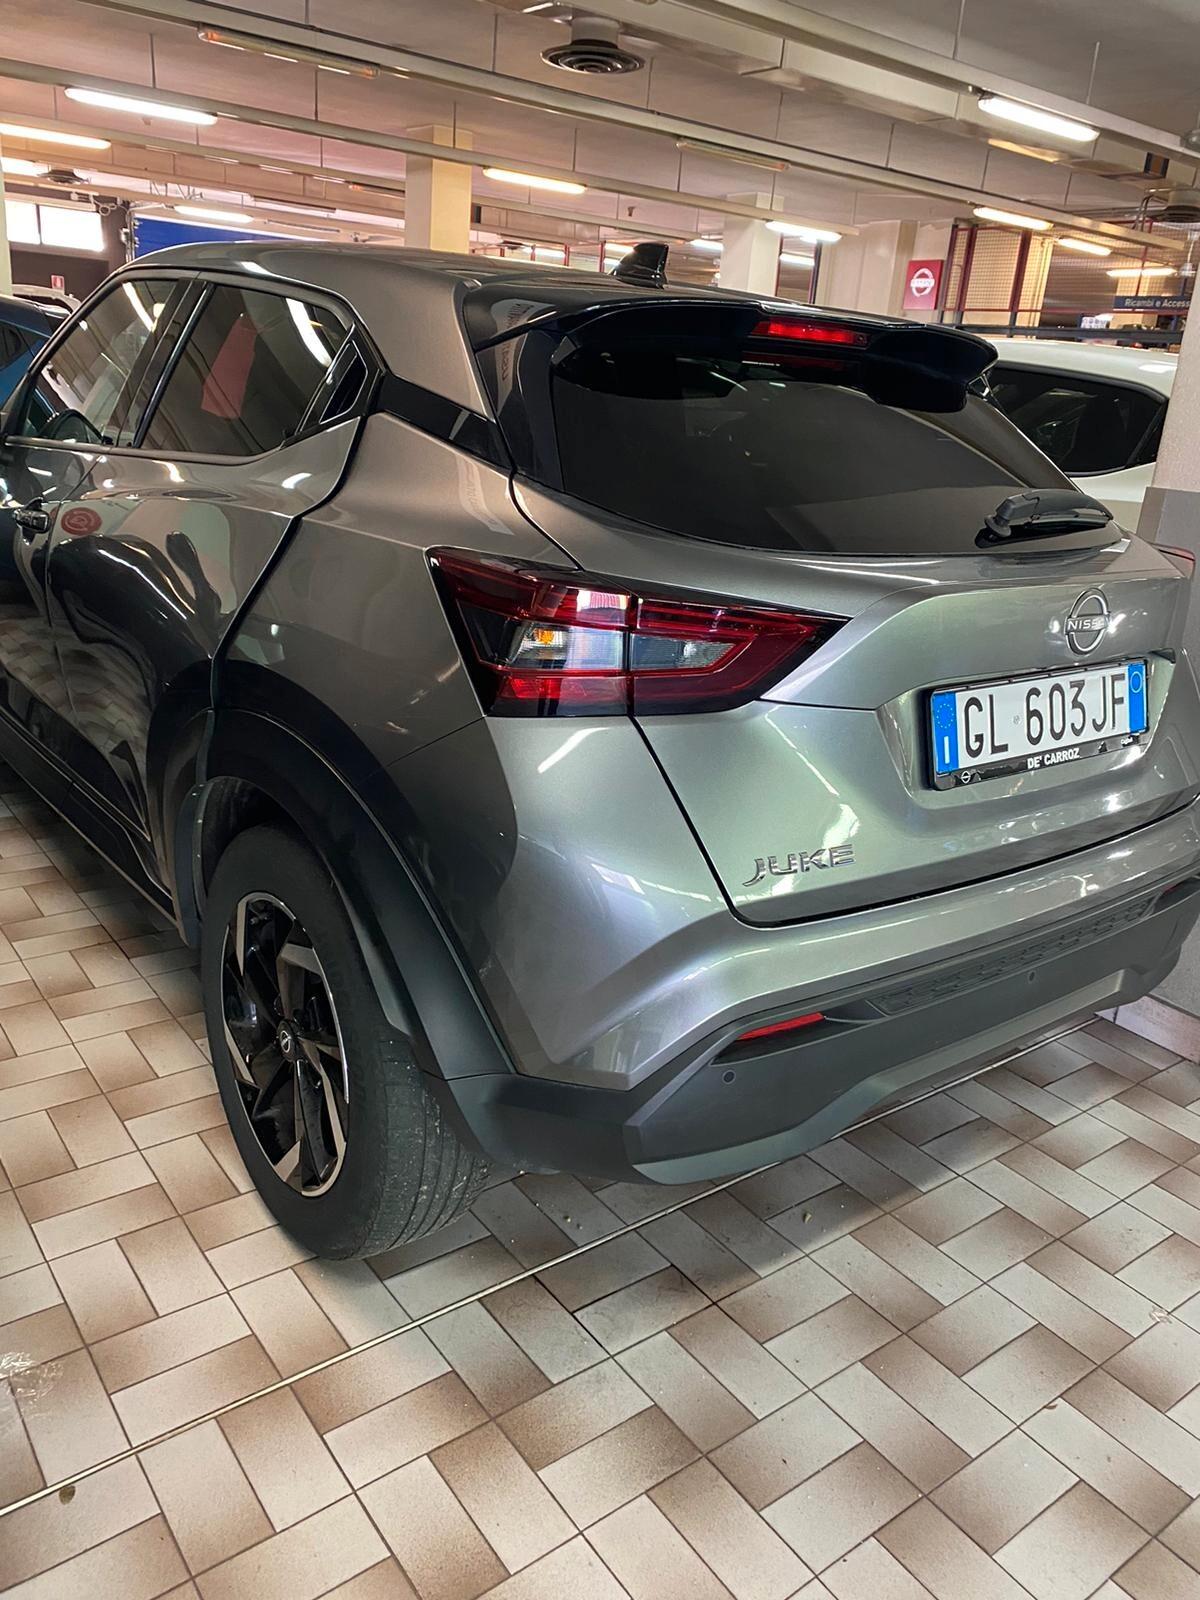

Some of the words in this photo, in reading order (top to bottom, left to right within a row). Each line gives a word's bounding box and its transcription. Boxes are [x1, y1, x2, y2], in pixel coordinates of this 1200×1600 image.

[1124, 298, 1154, 307] Ricambi
[964, 694, 1008, 758] GL
[1043, 748, 1081, 765] CARROZ
[742, 844, 855, 887] JUKE
